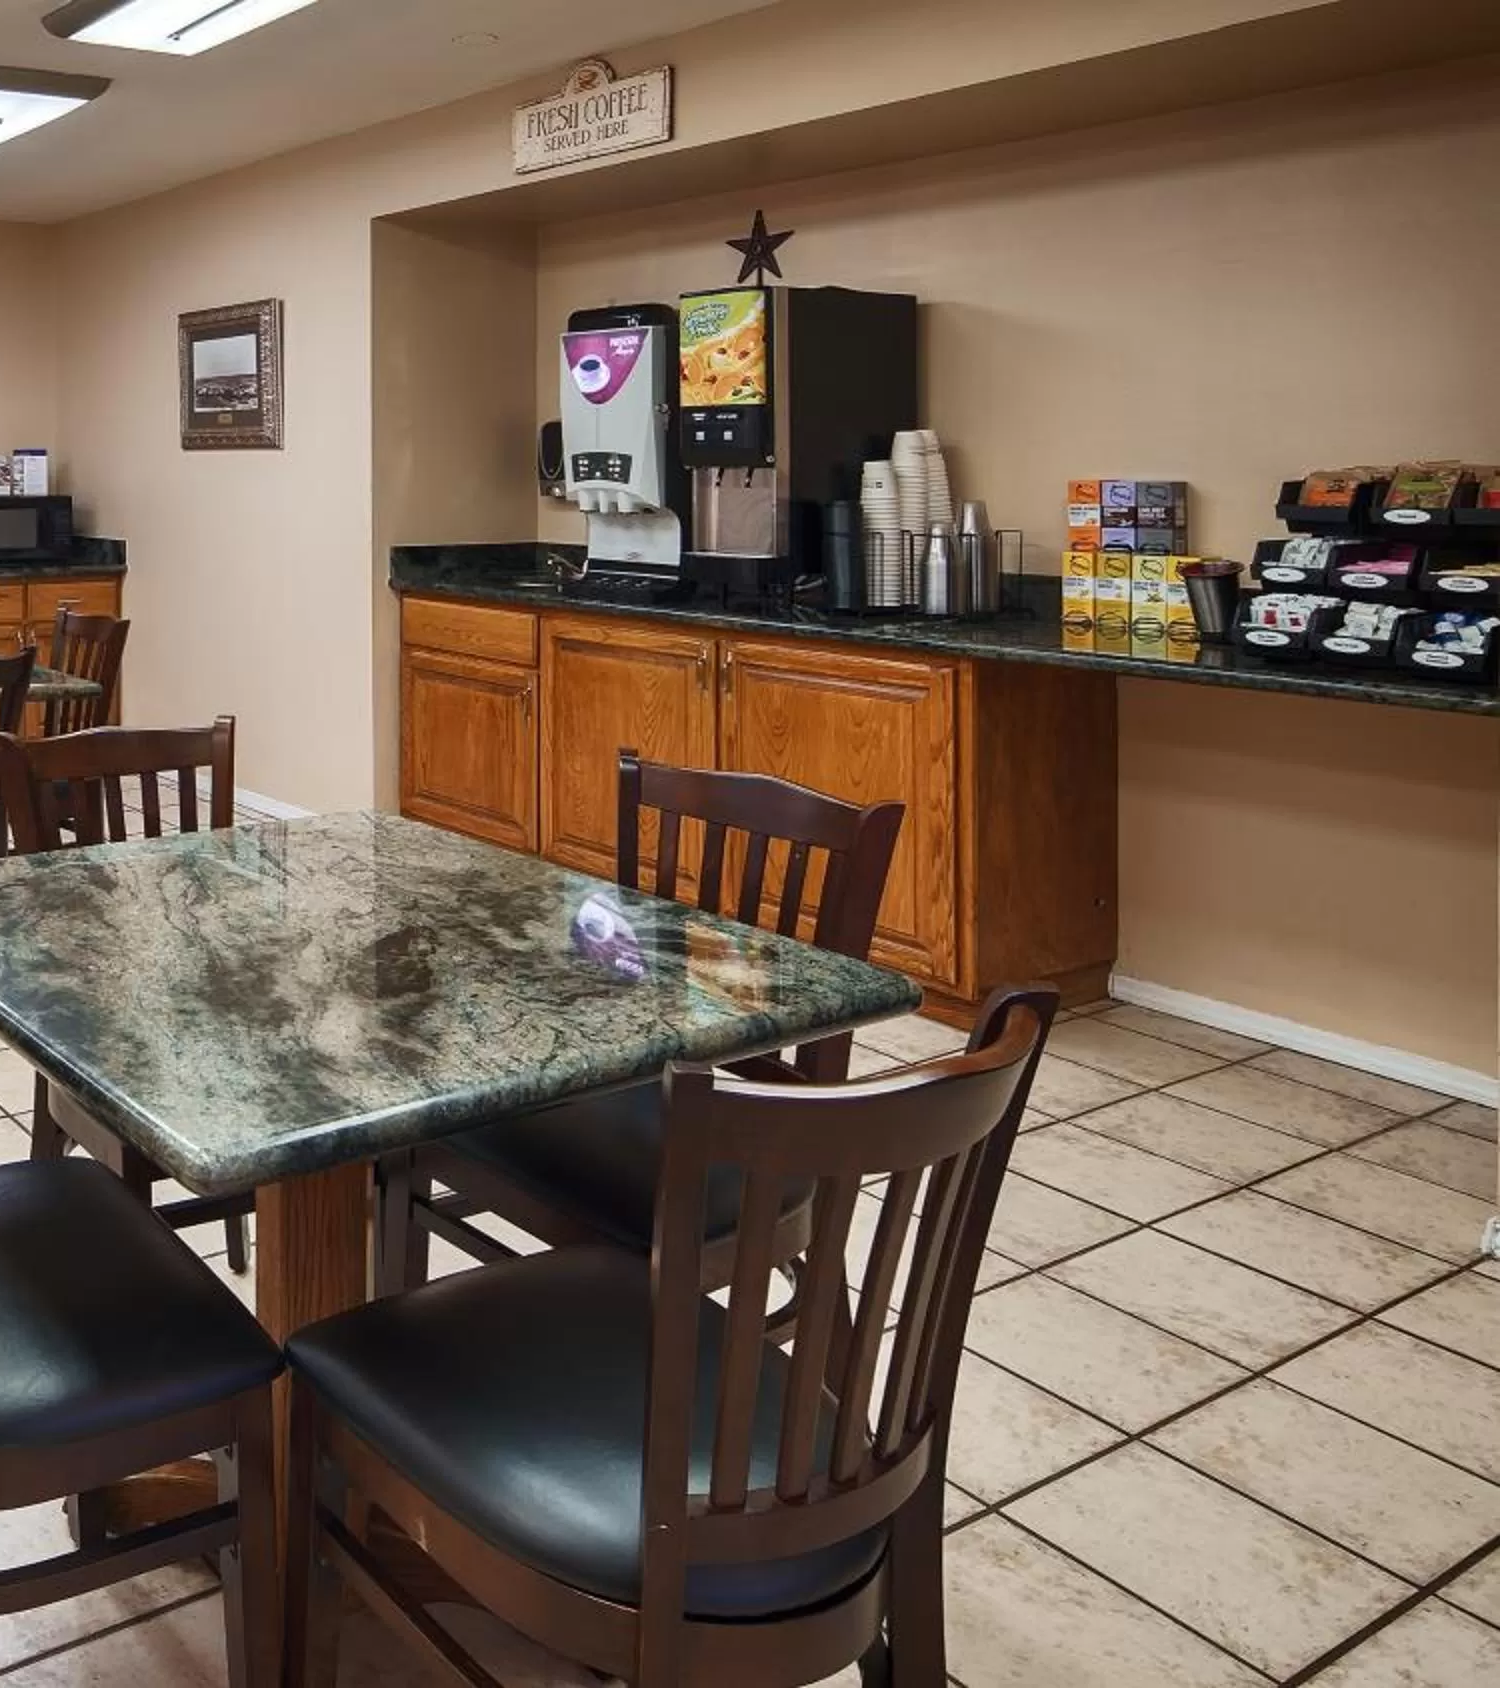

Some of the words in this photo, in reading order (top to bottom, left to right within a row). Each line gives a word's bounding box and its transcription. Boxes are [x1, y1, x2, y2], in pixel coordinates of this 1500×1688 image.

[527, 102, 579, 138] FRESH
[584, 83, 648, 124] COFFEE
[544, 128, 591, 153] SERVED
[597, 119, 629, 140] HERE
